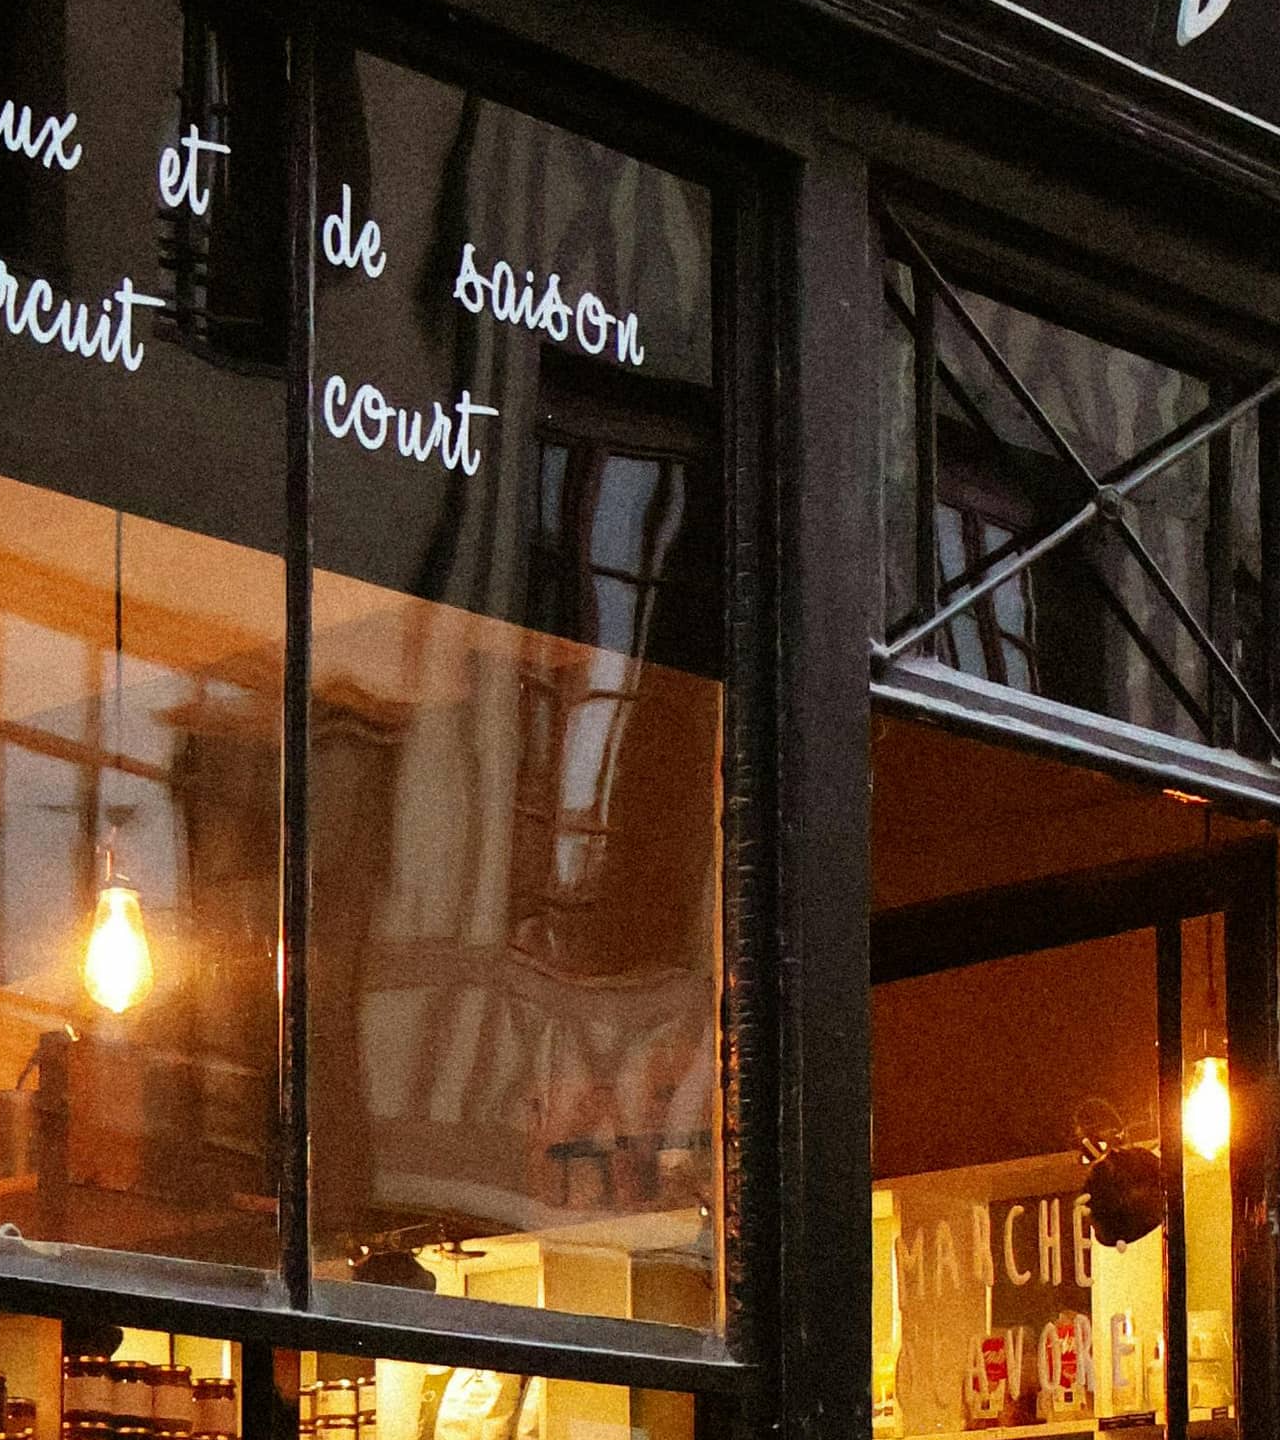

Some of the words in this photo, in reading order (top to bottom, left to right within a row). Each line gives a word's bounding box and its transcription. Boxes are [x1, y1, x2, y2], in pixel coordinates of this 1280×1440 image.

[159, 124, 230, 216] et
[321, 184, 387, 279] de
[453, 241, 645, 366] saison
[321, 373, 499, 479] court
